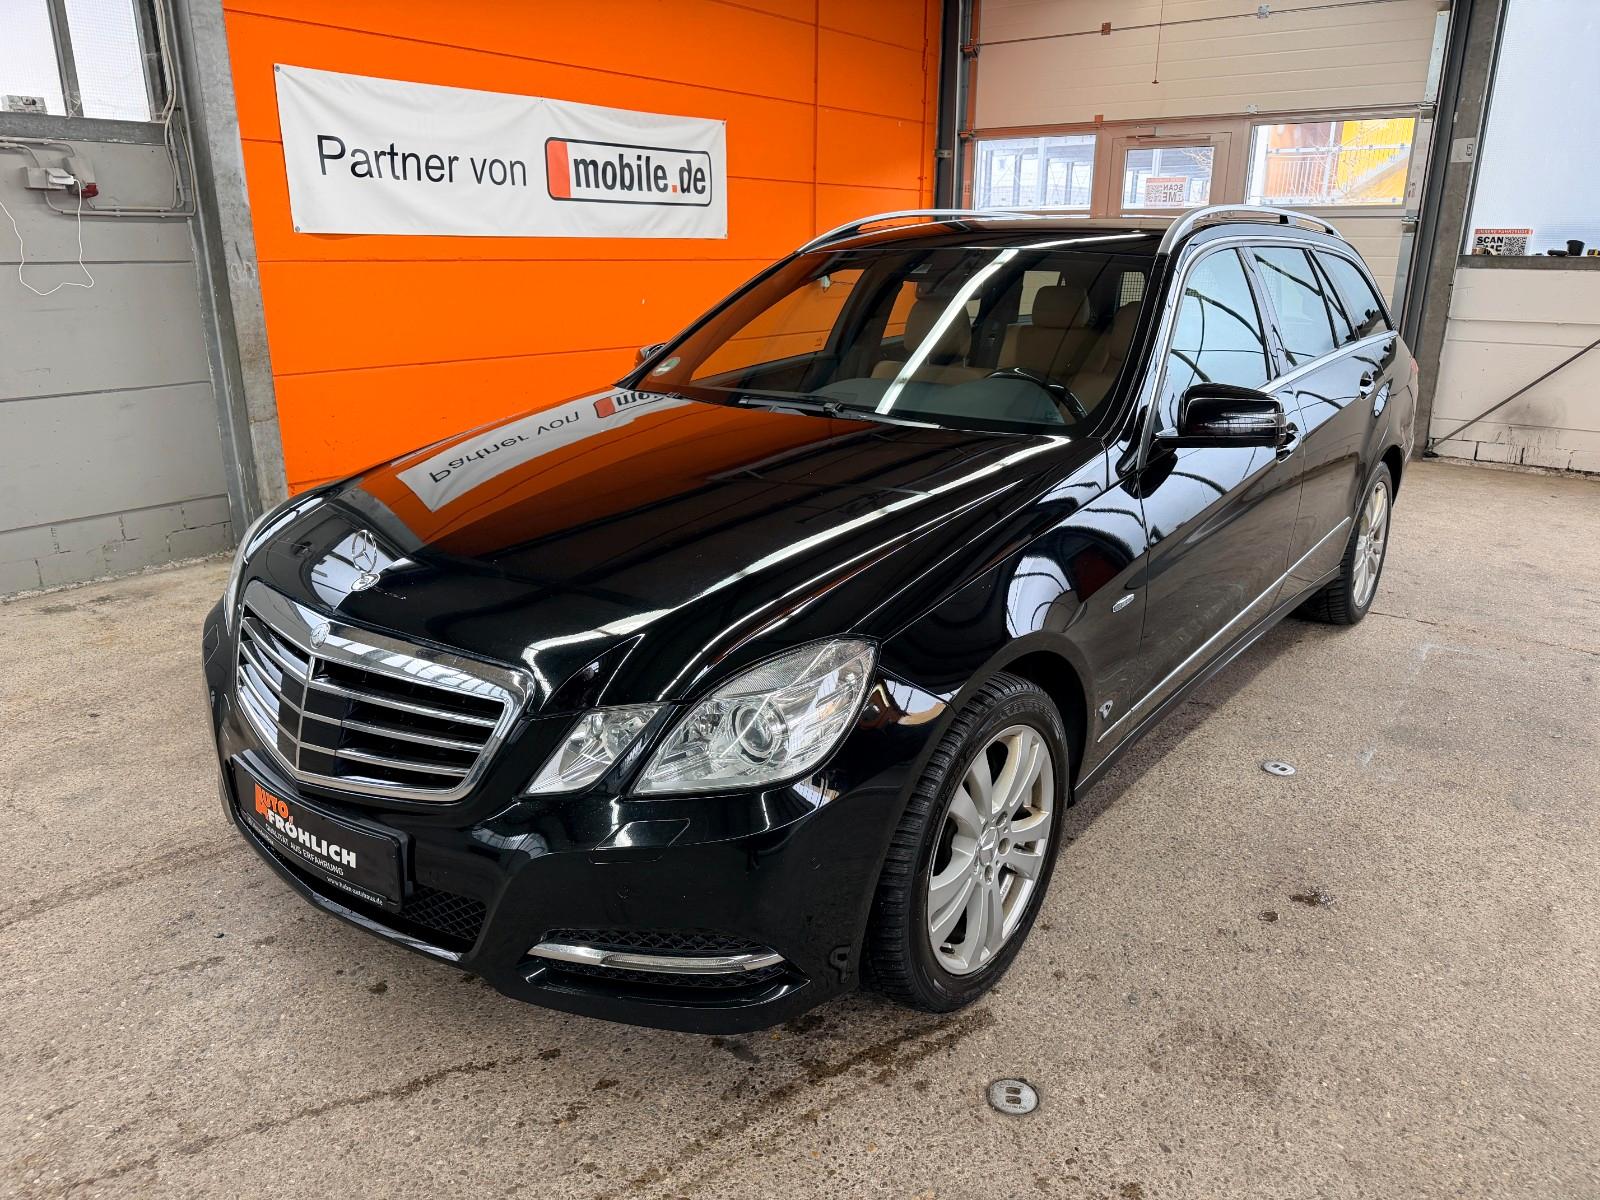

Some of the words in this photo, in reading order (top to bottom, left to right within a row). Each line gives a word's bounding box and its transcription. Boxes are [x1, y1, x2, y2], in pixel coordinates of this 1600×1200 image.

[316, 134, 459, 184] Partner
[470, 157, 528, 187] von
[573, 153, 707, 195] mobile.de
[254, 783, 289, 819] AUTO
[267, 811, 357, 869] FRÖHLICH
[302, 849, 344, 876] ERFAHRUNG
